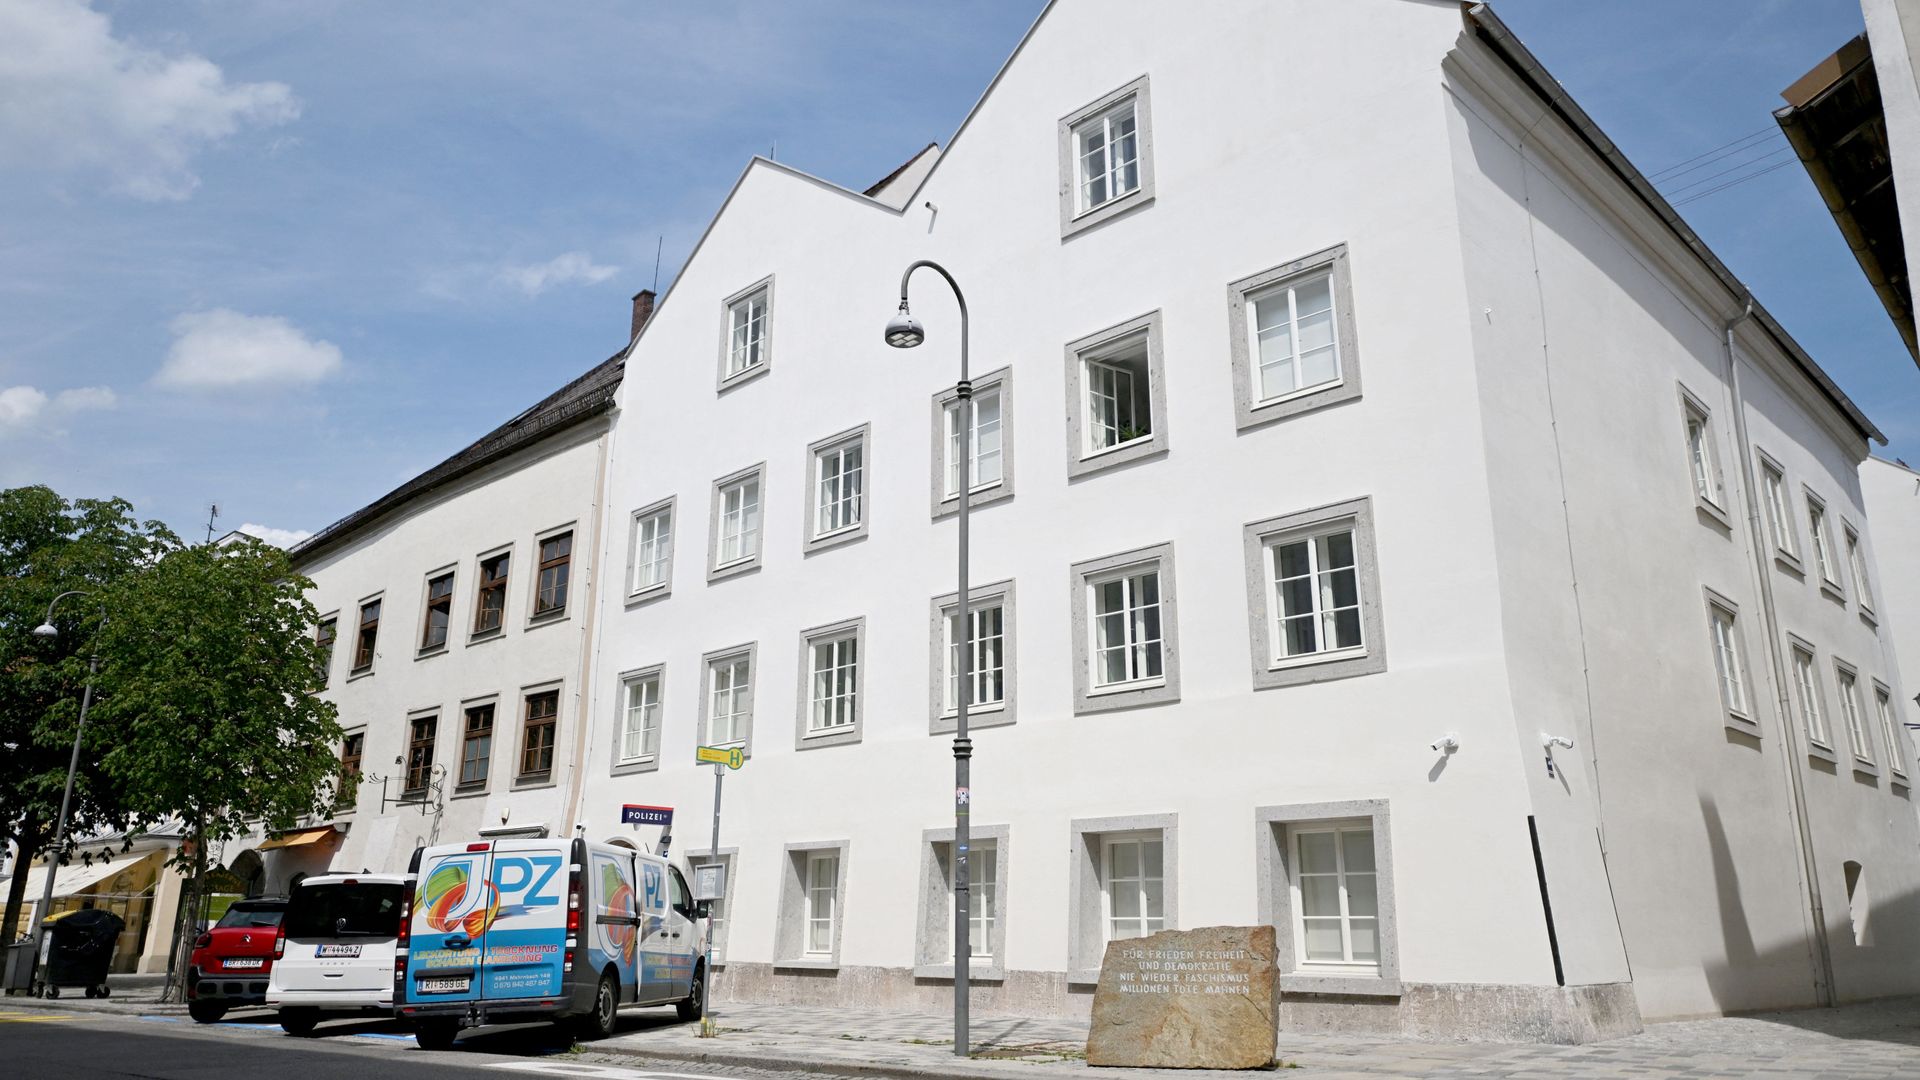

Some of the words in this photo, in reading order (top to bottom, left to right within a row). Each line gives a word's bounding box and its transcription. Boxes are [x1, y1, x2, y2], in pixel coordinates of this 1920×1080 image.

[730, 751, 740, 766] H
[628, 811, 663, 821] POLIZEI
[491, 944, 559, 956] TROCKNUNG
[1149, 950, 1194, 960] FRIEDEN
[1199, 950, 1246, 960] FREIHEIT
[1138, 961, 1160, 970] UND
[1164, 961, 1232, 971] DEMOKRATIE
[1119, 973, 1136, 982] NIE
[1140, 973, 1179, 983] WIEDER
[1184, 973, 1250, 983] FASCHISMUS
[1119, 984, 1170, 994] MILLIONEN
[1173, 984, 1199, 994] TOTE
[1204, 984, 1250, 994] MAHNEN
